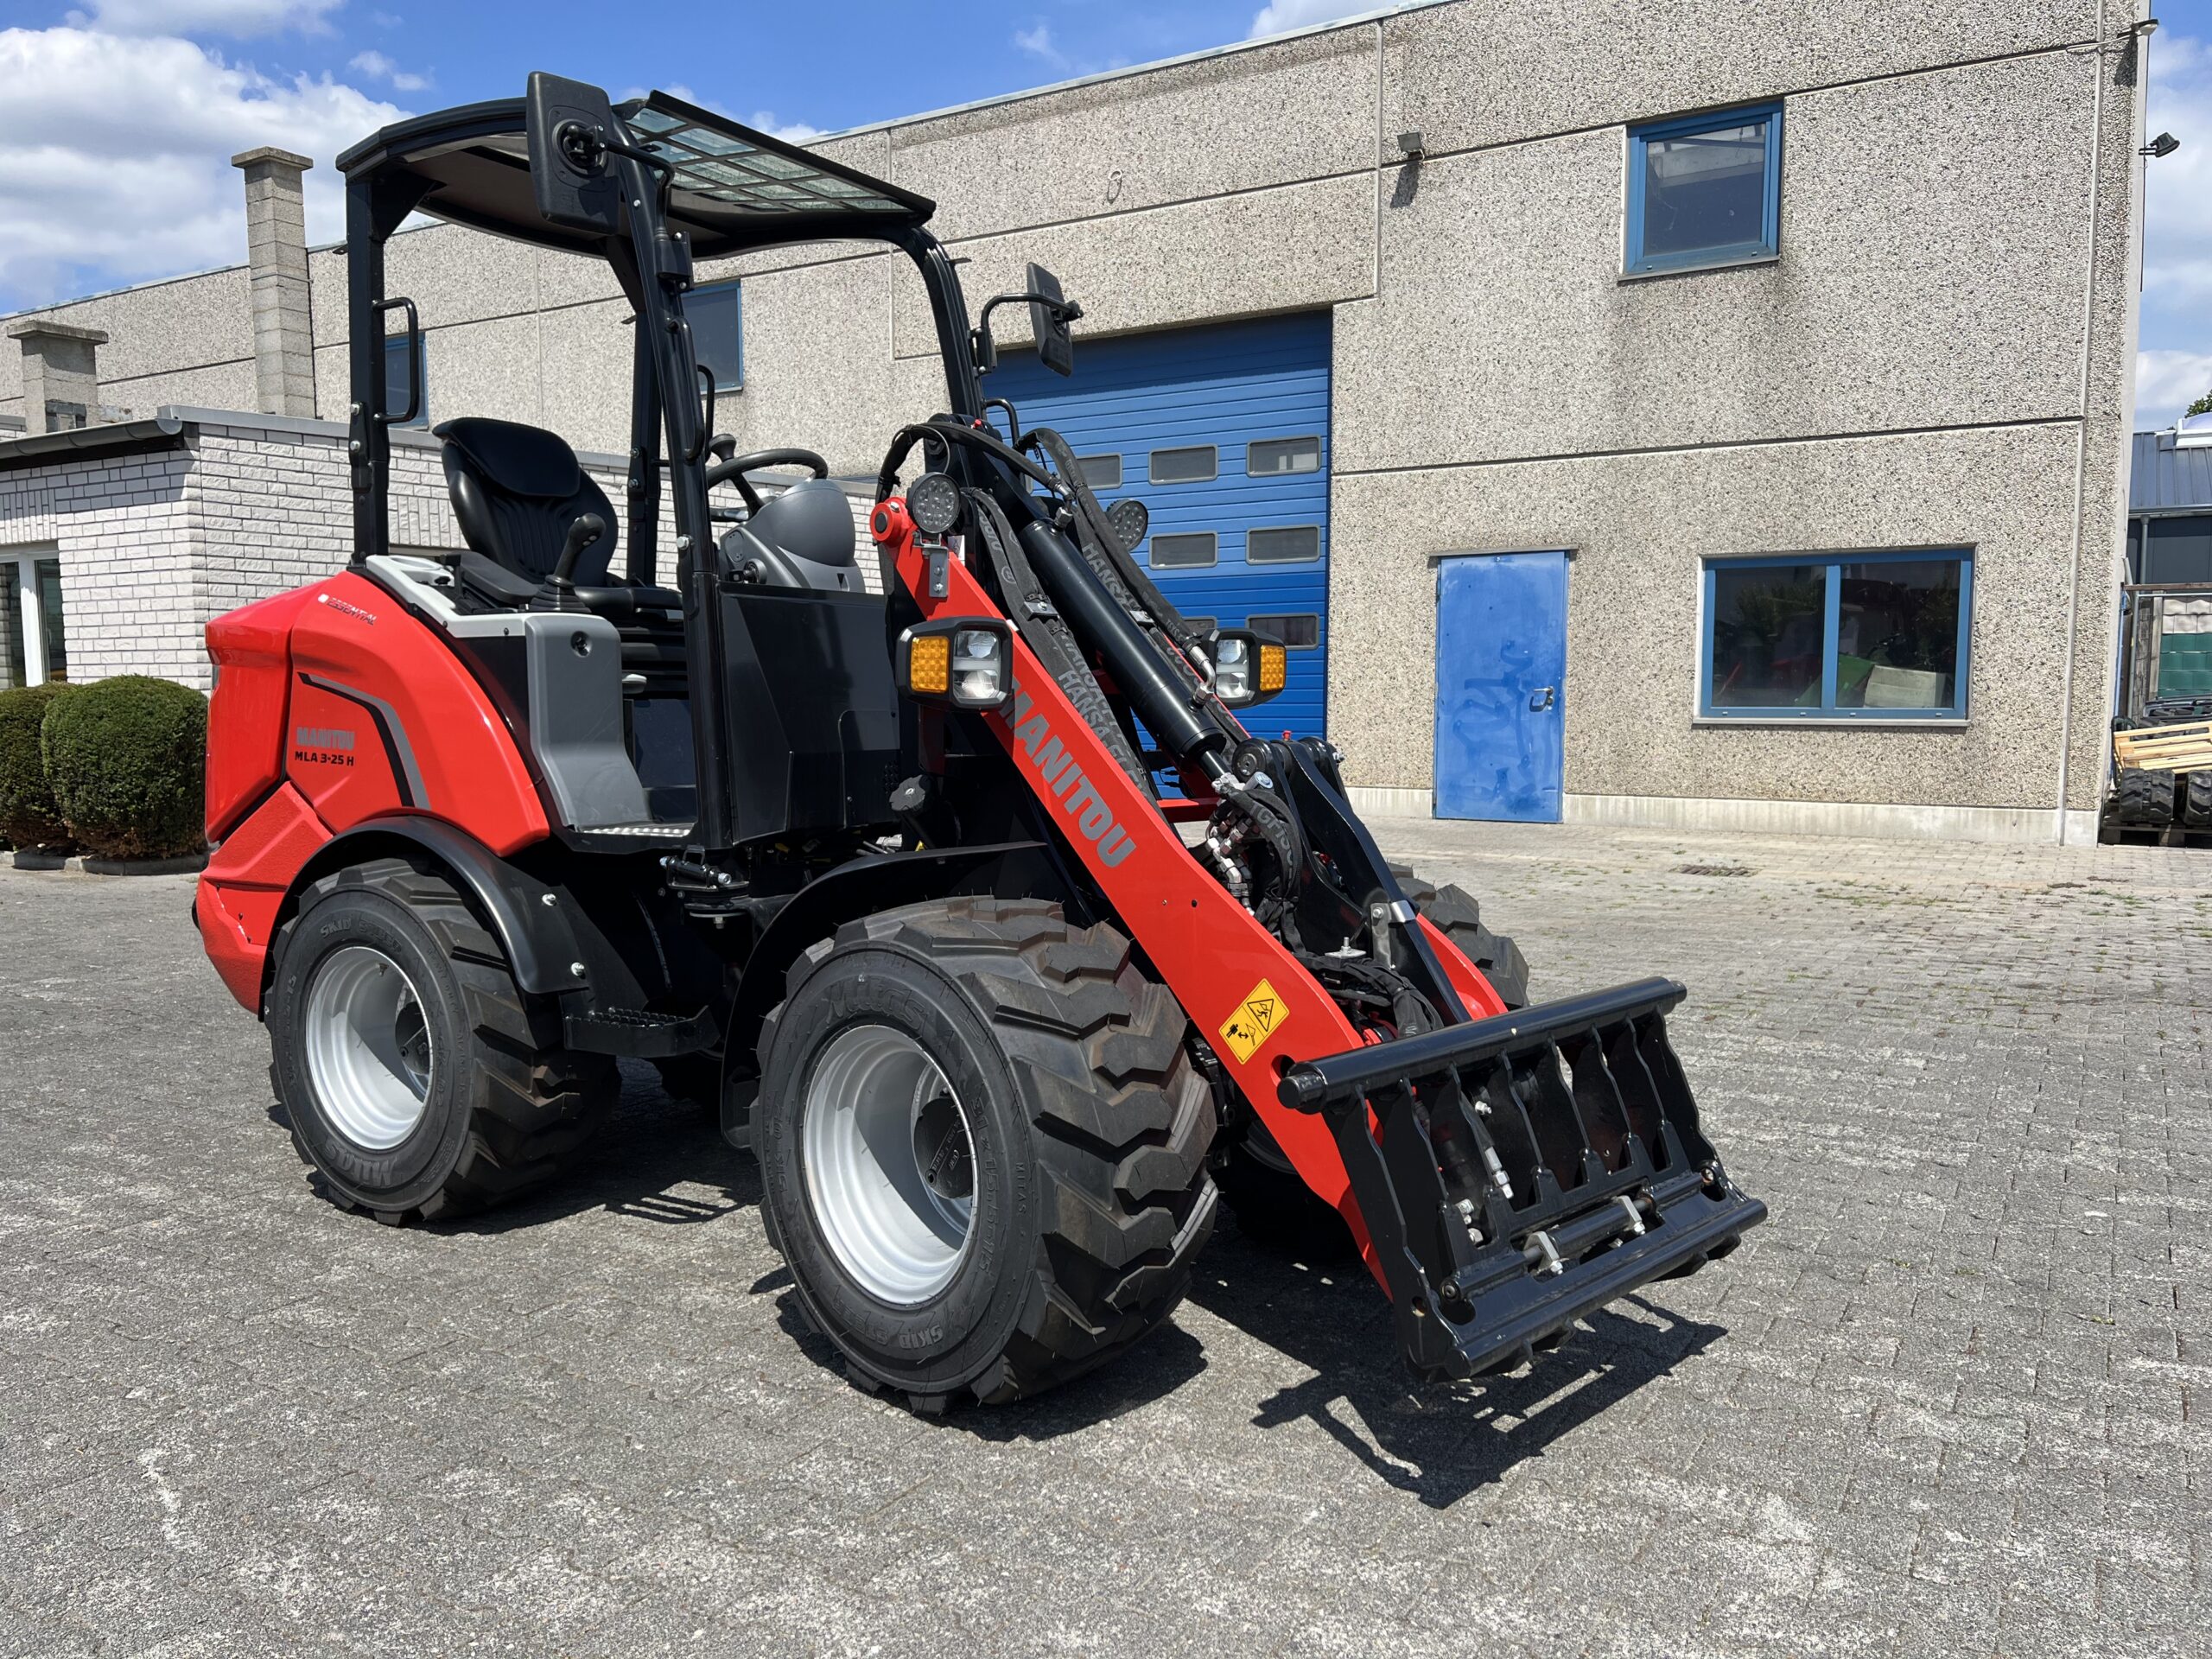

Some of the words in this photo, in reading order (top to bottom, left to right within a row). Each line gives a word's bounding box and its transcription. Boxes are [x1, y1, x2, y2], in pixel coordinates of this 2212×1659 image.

[327, 597, 377, 626] ESSENTIAL
[296, 726, 355, 751] MANITOU
[295, 751, 318, 763] MLA
[346, 756, 354, 766] H
[320, 917, 352, 939] SKID
[1014, 1161, 1027, 1217] MITAS
[899, 1324, 944, 1350] SKID
